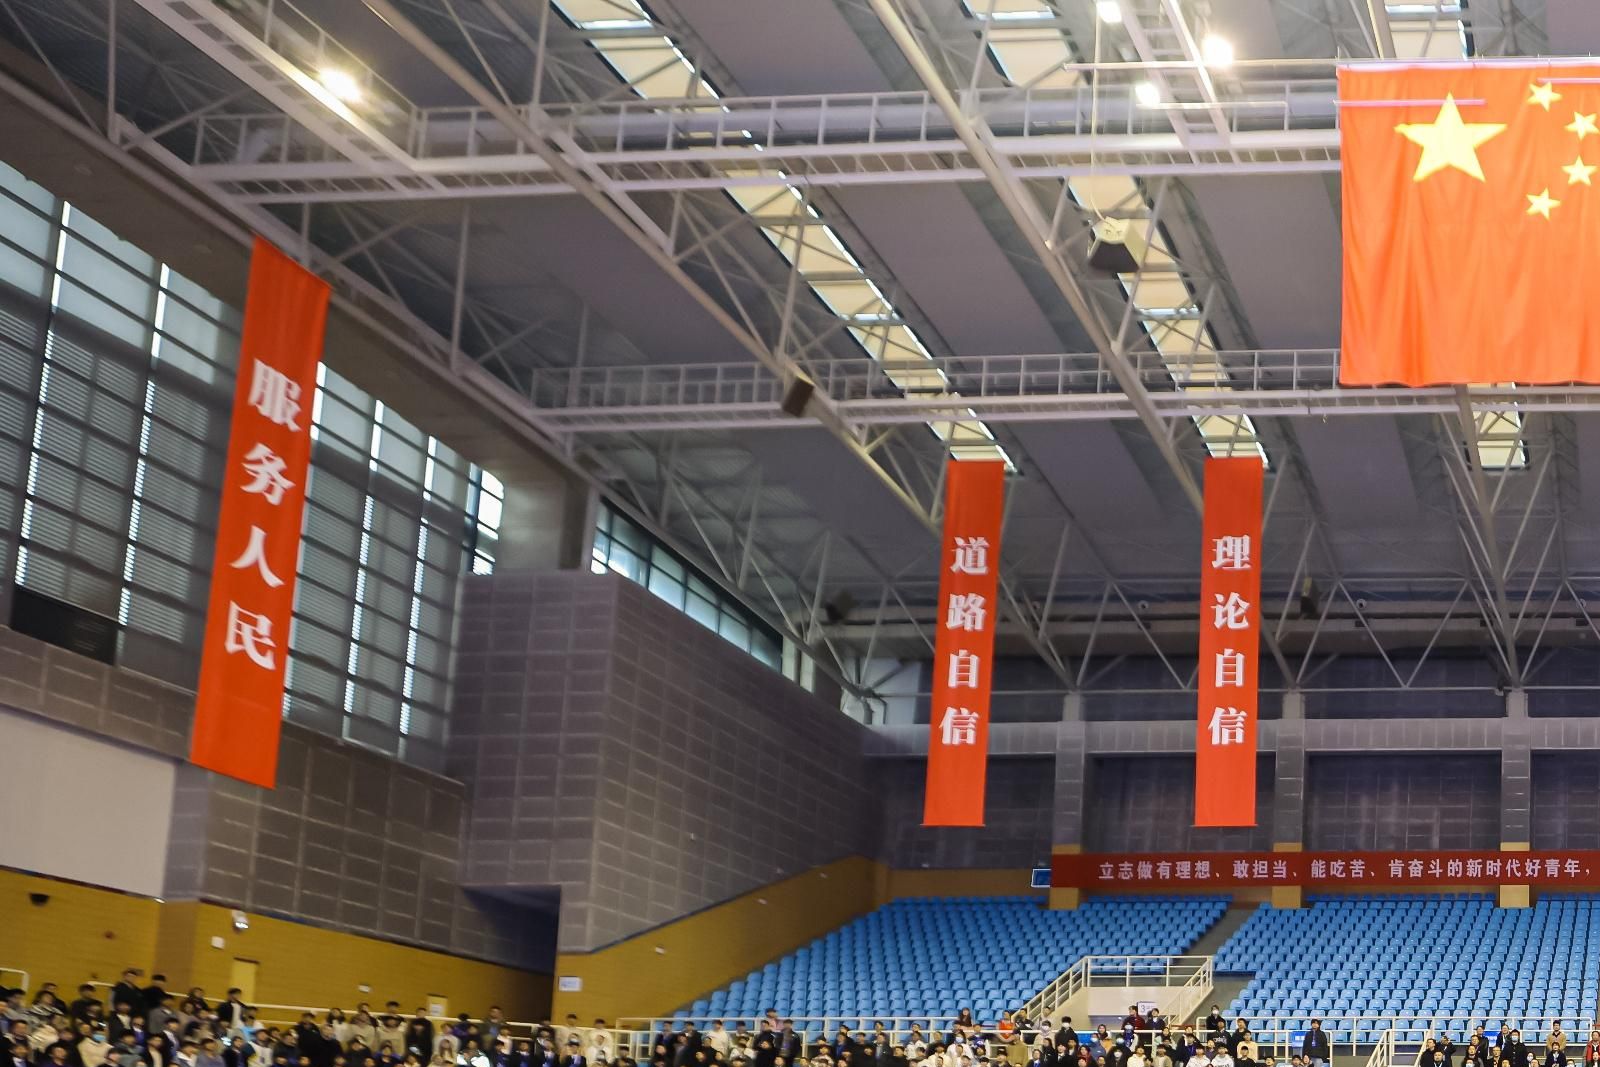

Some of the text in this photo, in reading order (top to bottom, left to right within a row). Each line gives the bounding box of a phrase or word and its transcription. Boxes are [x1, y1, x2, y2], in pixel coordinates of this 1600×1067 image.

[224, 357, 302, 672] 服务人民
[939, 536, 990, 745] 道路自信
[1208, 535, 1251, 745] 理论自信
